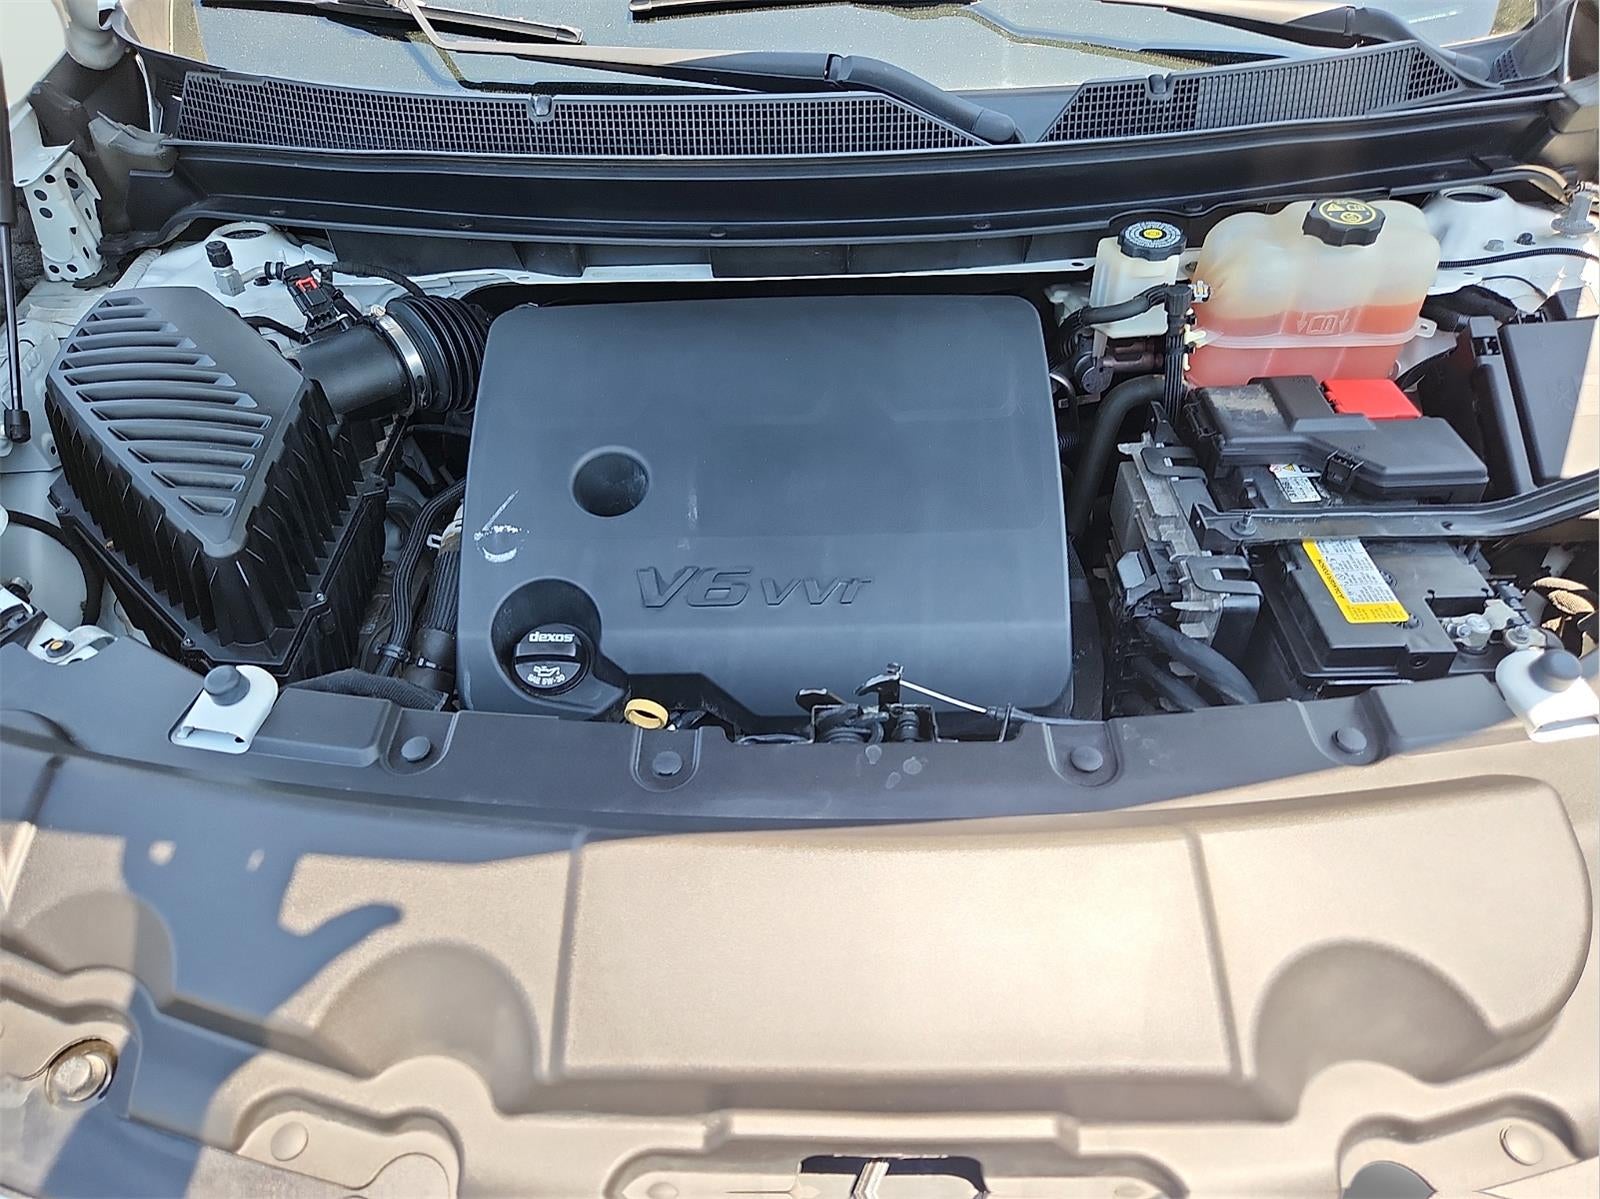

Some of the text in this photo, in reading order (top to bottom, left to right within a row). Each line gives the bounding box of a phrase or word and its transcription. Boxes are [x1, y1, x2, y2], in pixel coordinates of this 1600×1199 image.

[636, 566, 752, 608] V6
[529, 631, 575, 643] dexos
[542, 674, 565, 686] 5W-30
